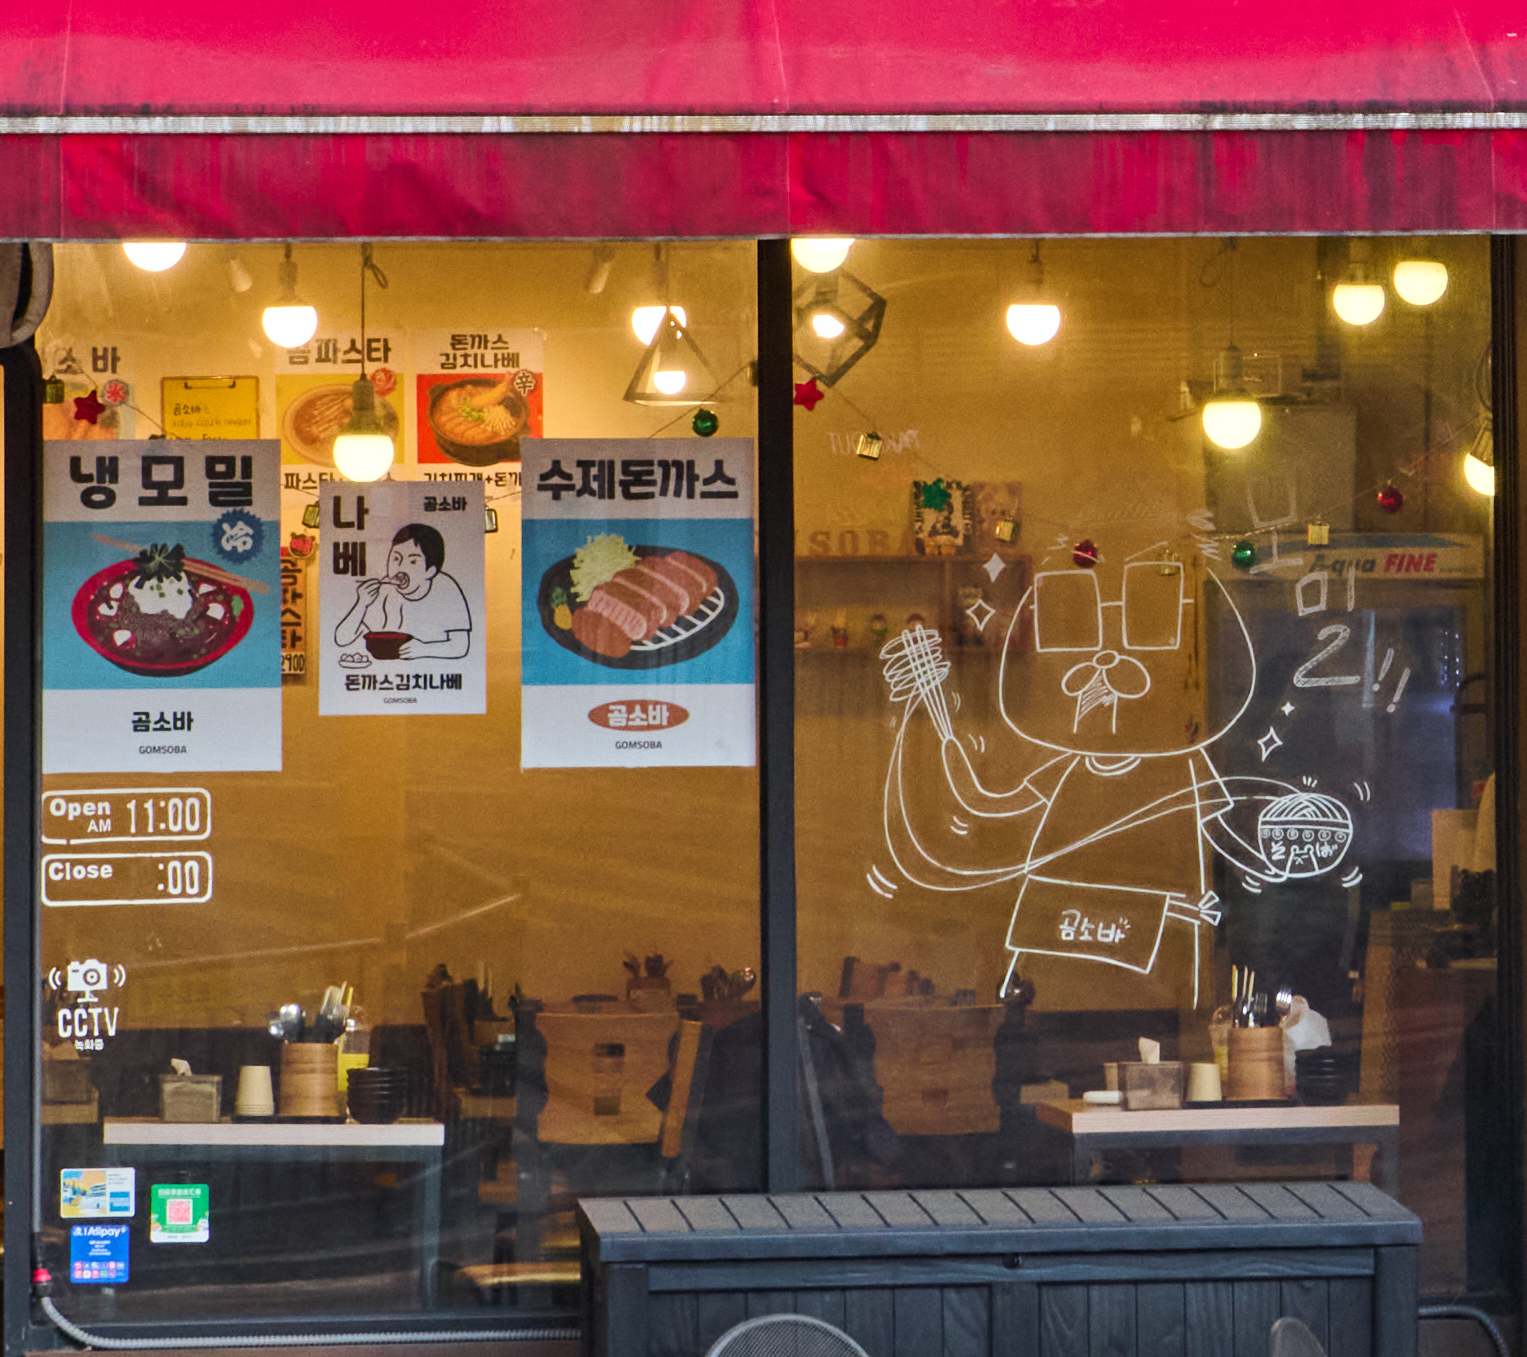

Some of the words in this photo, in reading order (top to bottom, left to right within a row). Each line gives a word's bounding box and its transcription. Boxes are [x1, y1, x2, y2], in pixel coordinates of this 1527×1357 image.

[450, 334, 510, 351] 돈까스
[44, 345, 121, 375] 소바
[439, 353, 520, 370] 김치나베
[69, 455, 254, 510] 냉모밀
[537, 456, 740, 502] 수제돈까스
[423, 496, 467, 512] 곰소바
[332, 495, 370, 577] 나베
[1384, 553, 1436, 573] FINE
[345, 673, 462, 691] 돈까스김치나베
[131, 709, 194, 733] 곰소바
[608, 702, 669, 727] 곰소바
[138, 744, 187, 755] GOMSOBA
[615, 739, 662, 750] GOMSOBA
[49, 798, 112, 821] Open
[126, 796, 201, 834] 11:00
[87, 818, 112, 832] AM
[48, 861, 113, 881] Close
[157, 860, 200, 895] :00
[57, 1007, 119, 1038] CCTV
[74, 1038, 105, 1050] 녹화중
